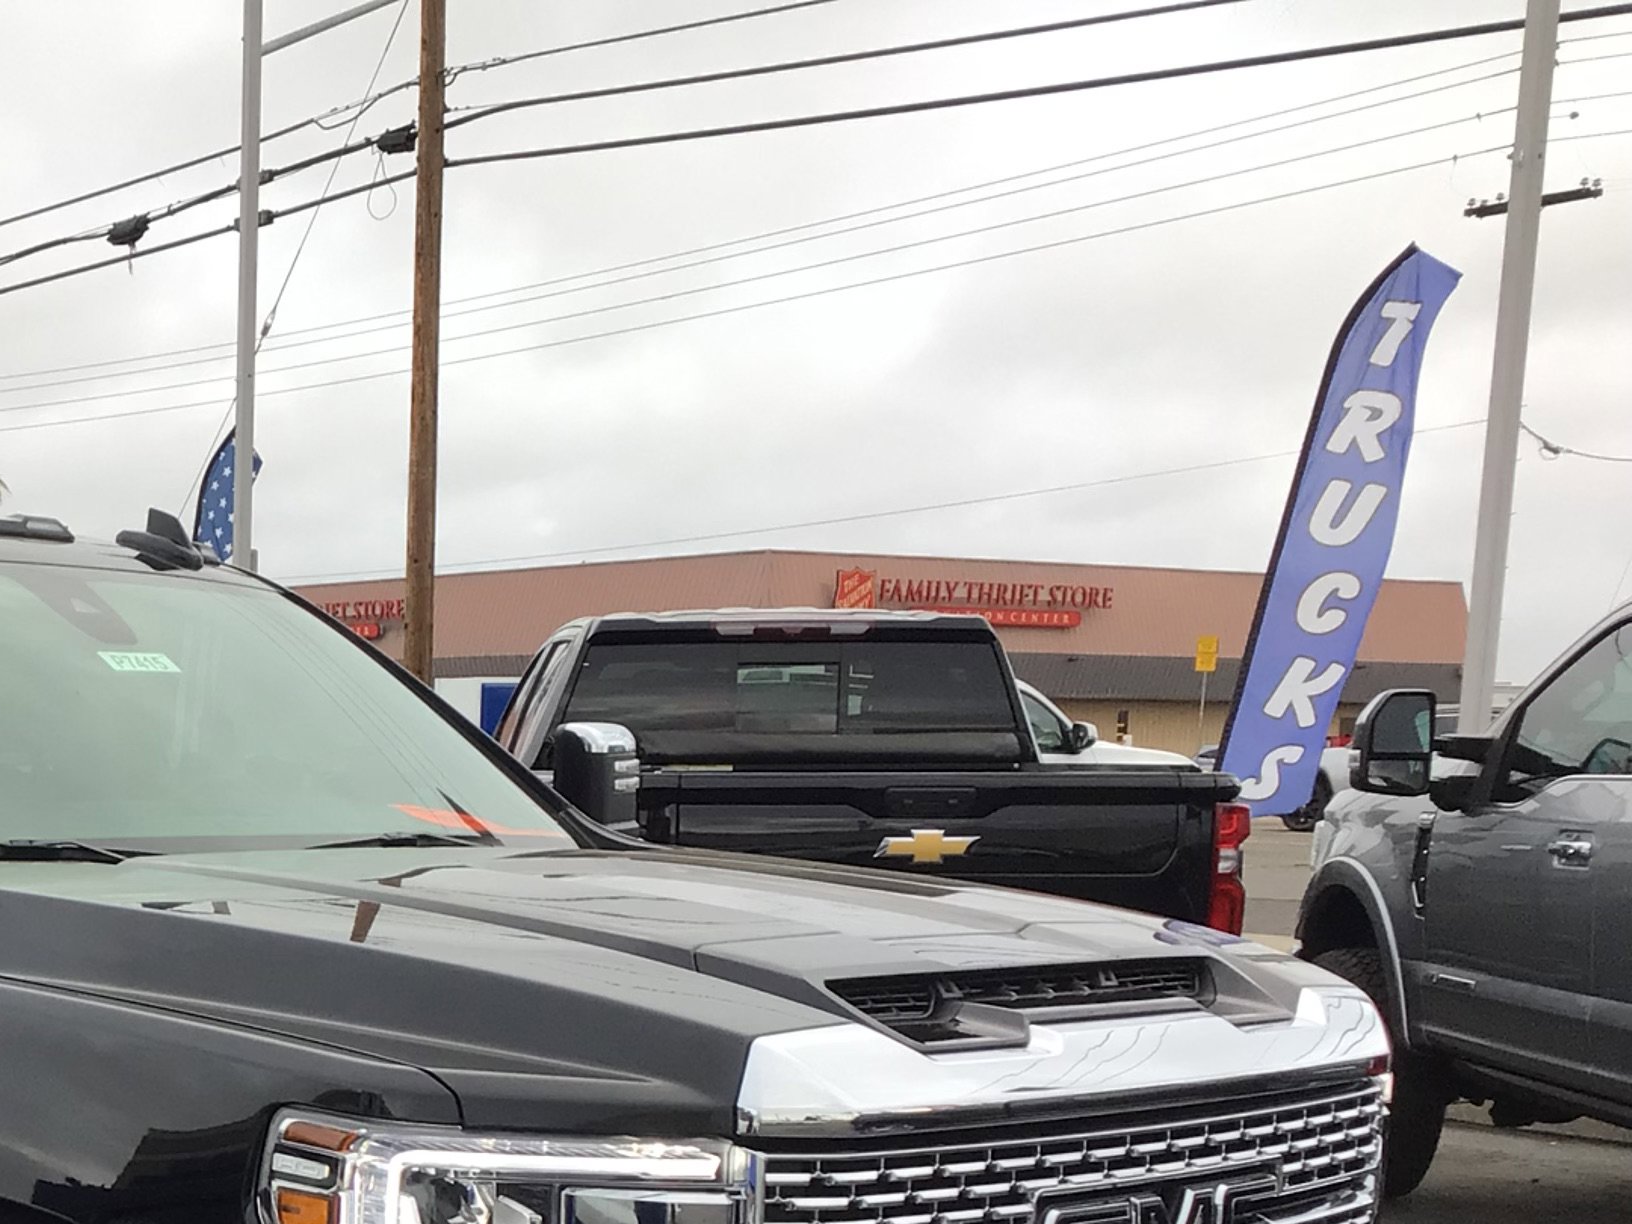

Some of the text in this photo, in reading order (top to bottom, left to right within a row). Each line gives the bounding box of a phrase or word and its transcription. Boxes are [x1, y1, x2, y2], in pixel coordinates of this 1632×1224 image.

[1236, 300, 1422, 801] TRUCKS
[879, 578, 961, 603] FAMILY
[963, 581, 1045, 606] THRIFT
[1048, 586, 1114, 610] STORE
[352, 599, 406, 620] STORE
[1009, 611, 1070, 624] CENTER
